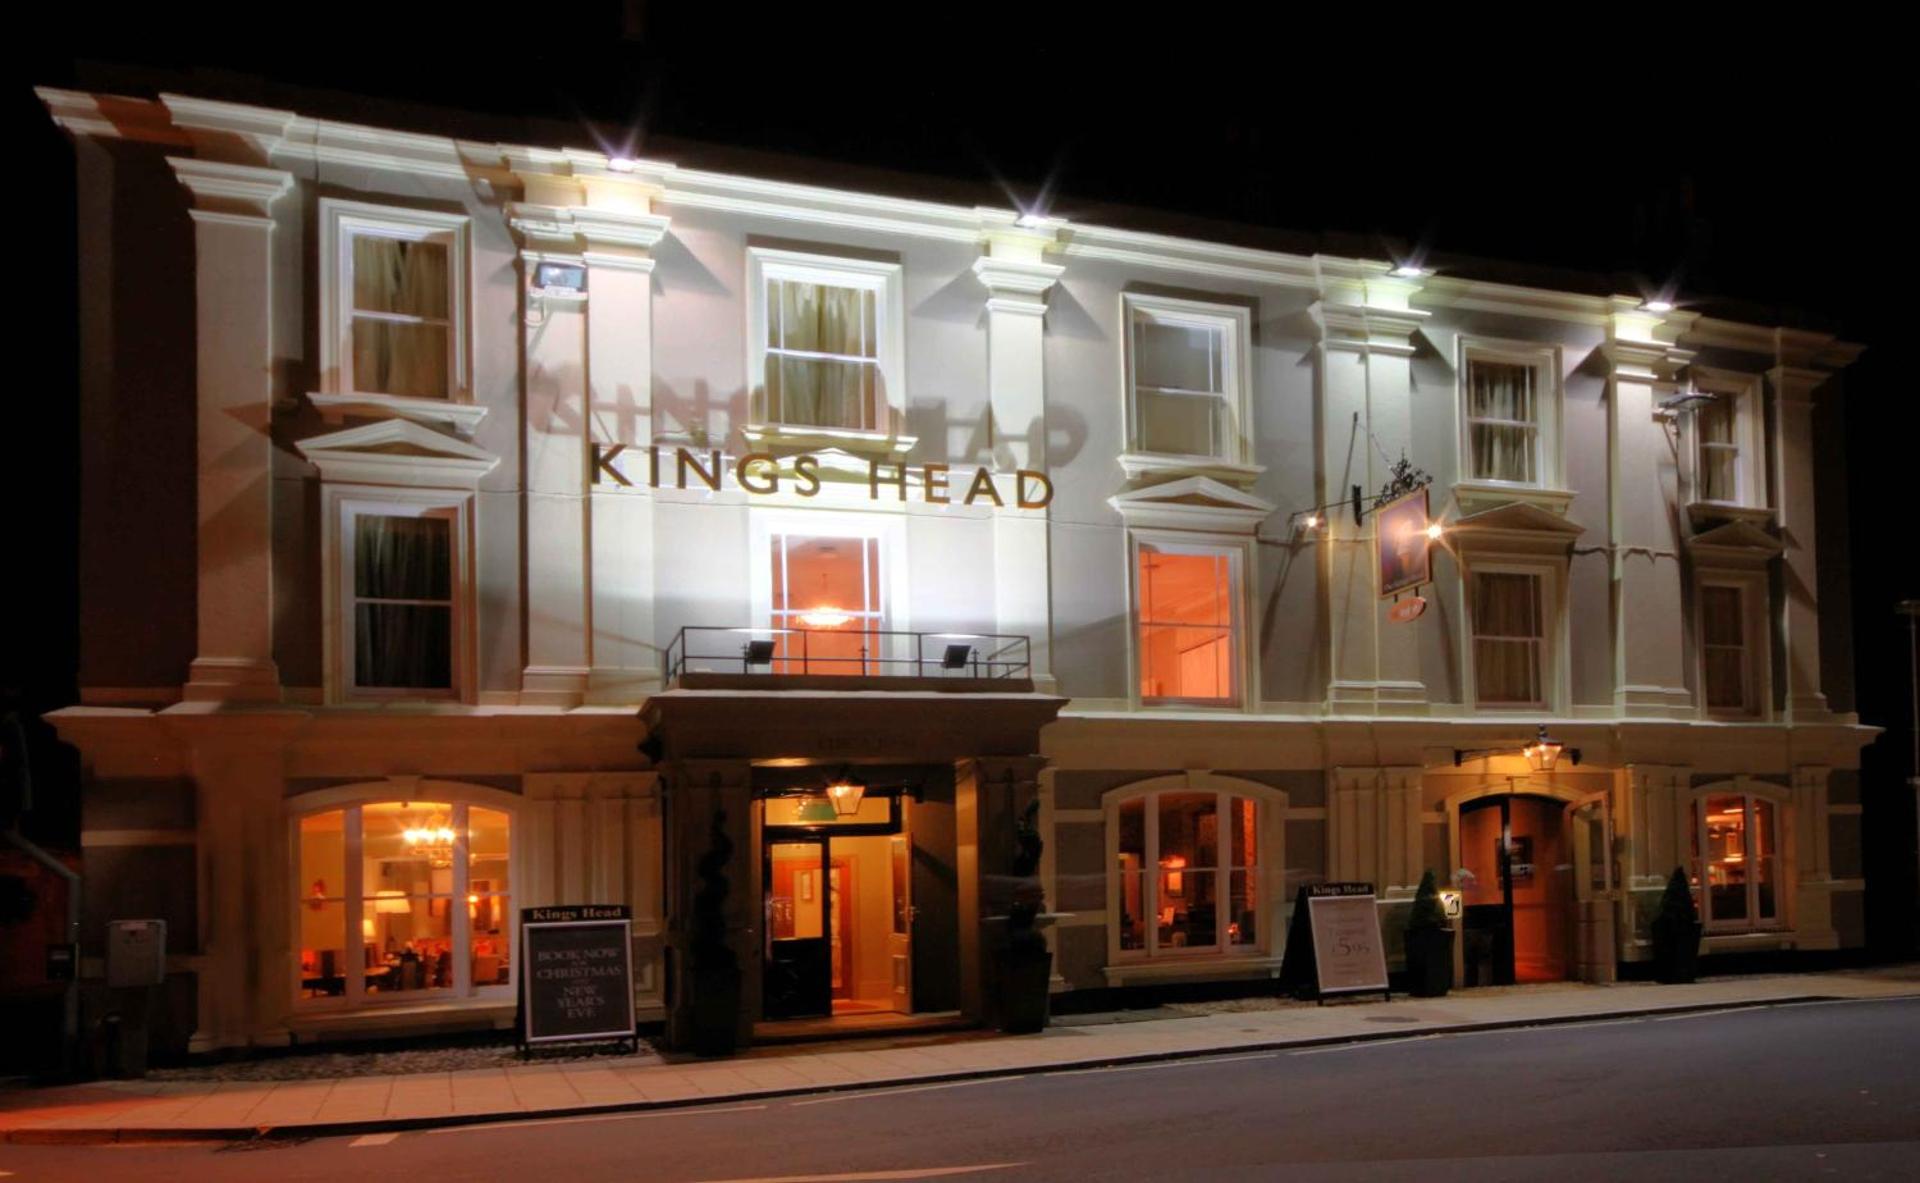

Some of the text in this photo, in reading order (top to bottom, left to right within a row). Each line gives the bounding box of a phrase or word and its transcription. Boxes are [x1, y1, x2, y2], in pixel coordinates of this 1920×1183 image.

[591, 442, 1055, 510] KINGS HEAD
[1312, 883, 1368, 895] Kings Head
[532, 907, 621, 922] Kings Head
[538, 947, 620, 962] BOOK NOW
[536, 966, 622, 979] CHRISTMAS
[562, 984, 597, 997] NEW
[567, 1008, 595, 1019] EVE
